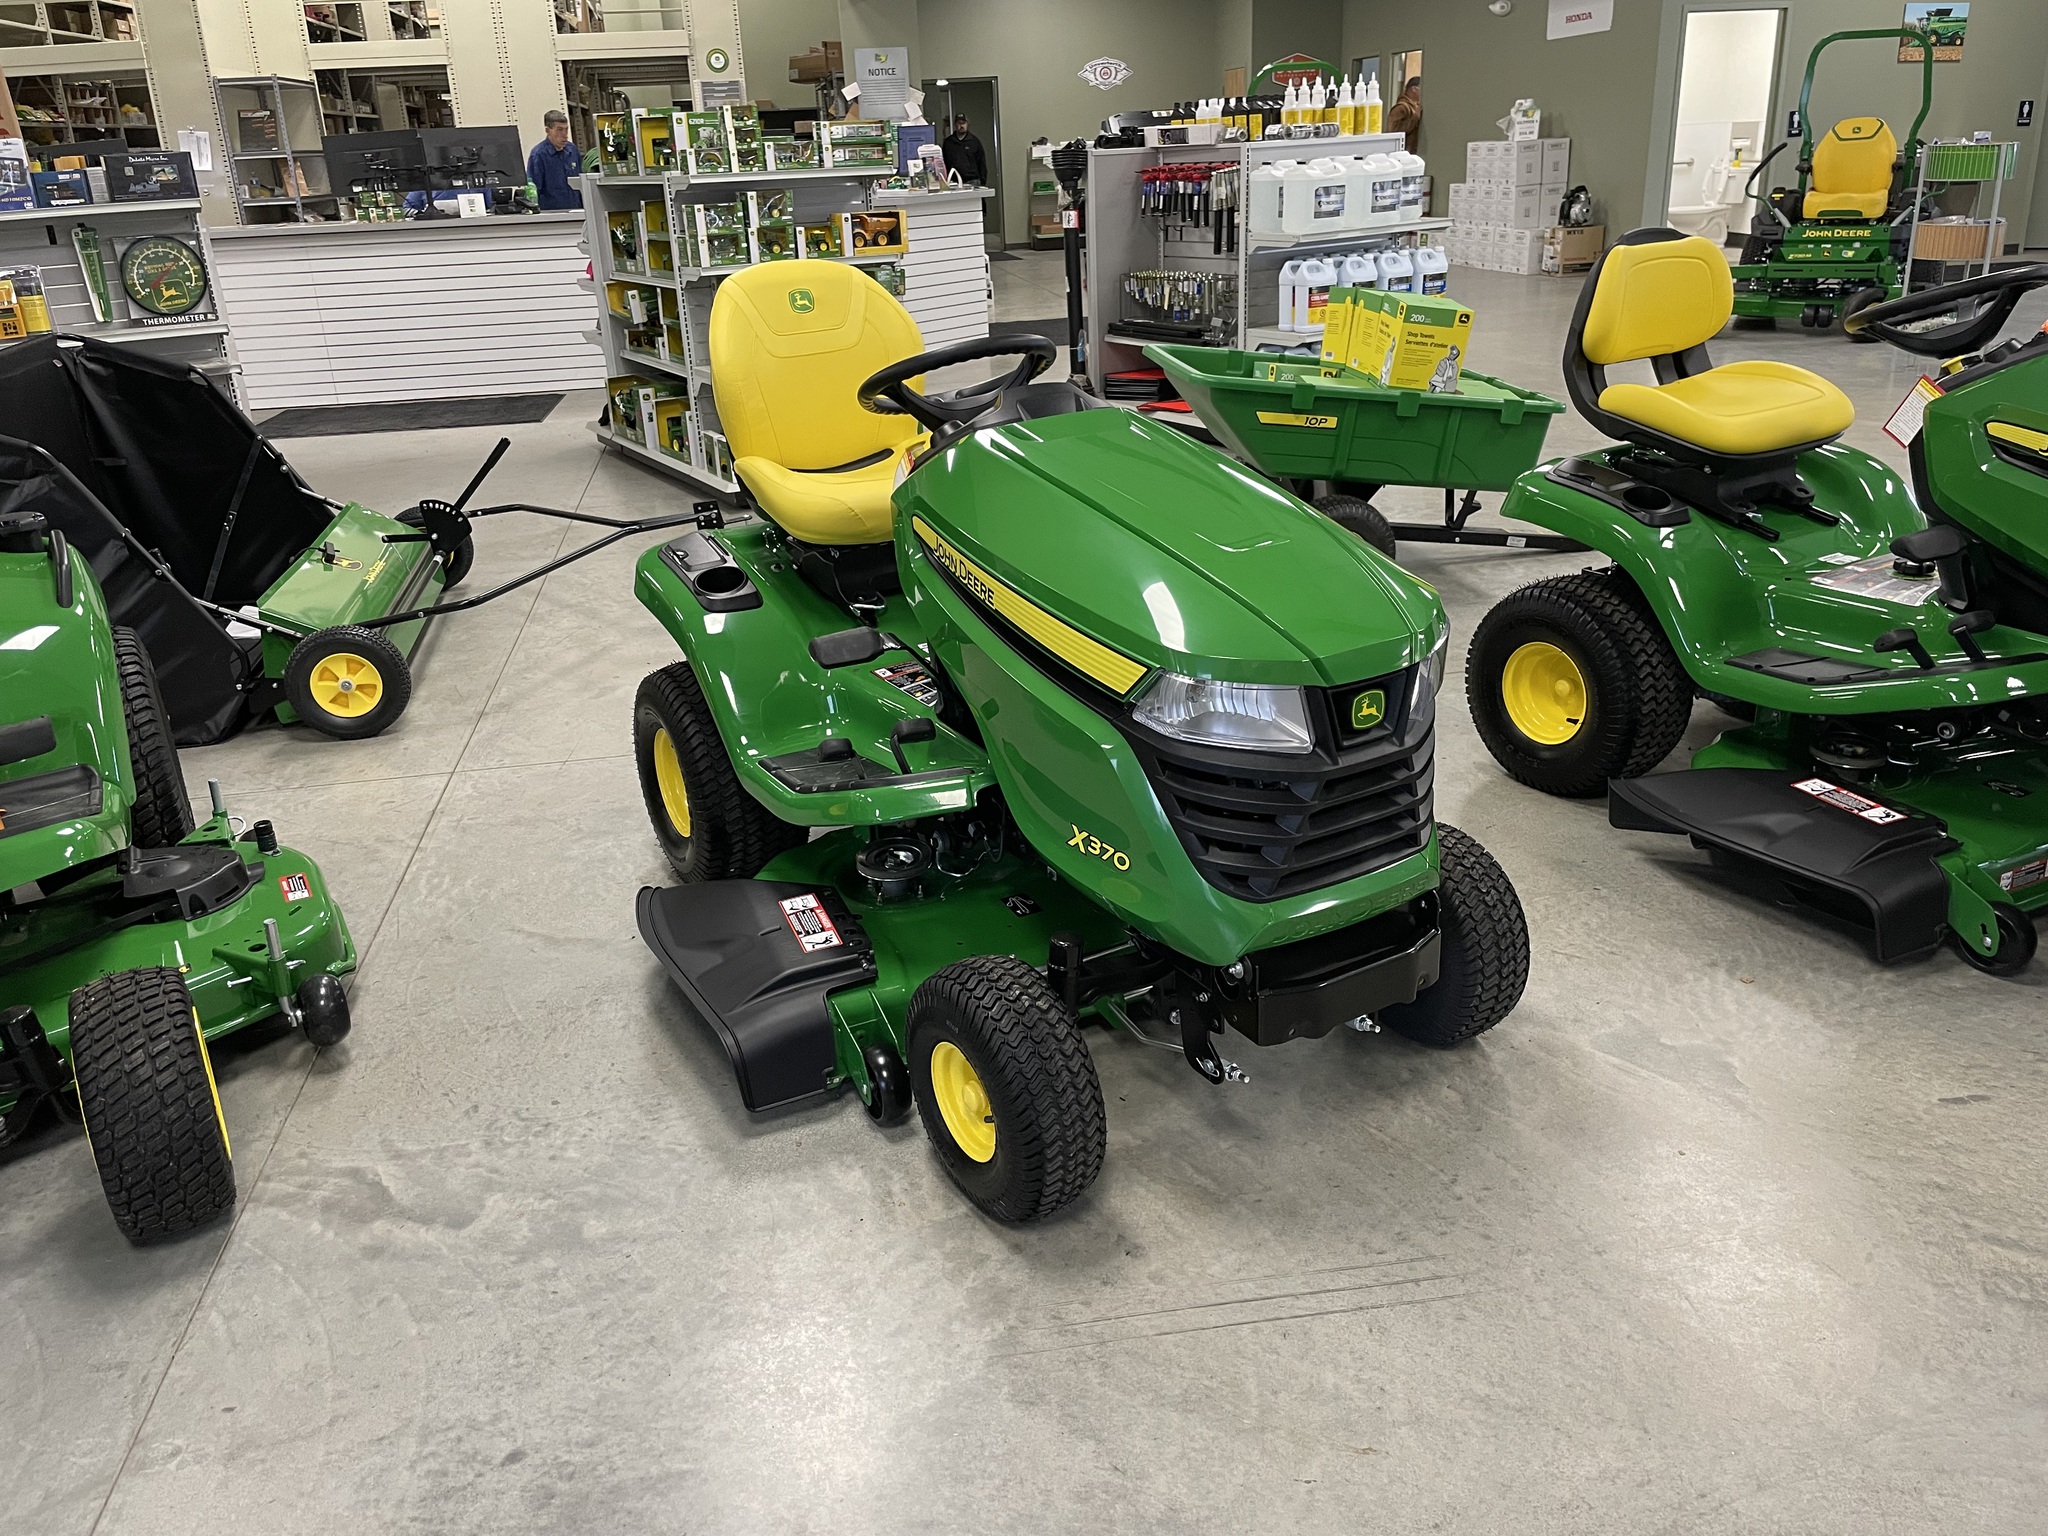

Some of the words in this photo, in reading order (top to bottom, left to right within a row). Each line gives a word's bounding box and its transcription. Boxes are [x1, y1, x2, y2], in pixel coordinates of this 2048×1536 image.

[1565, 12, 1592, 23] HONDA
[868, 67, 897, 76] NOTICE
[1802, 229, 1832, 238] JOHN
[1833, 229, 1872, 237] DEERE
[143, 314, 205, 326] THERMOMETER
[1410, 313, 1425, 322] 200
[1406, 331, 1419, 339] Shop
[1419, 332, 1435, 340] Towels
[1405, 339, 1429, 347] Serviettes
[1429, 341, 1449, 349] d'atelier
[1281, 373, 1295, 381] 200
[1304, 416, 1328, 427] 10P
[934, 536, 959, 575] JOHN
[959, 559, 996, 608] DEERE
[1065, 821, 1131, 872] X370
